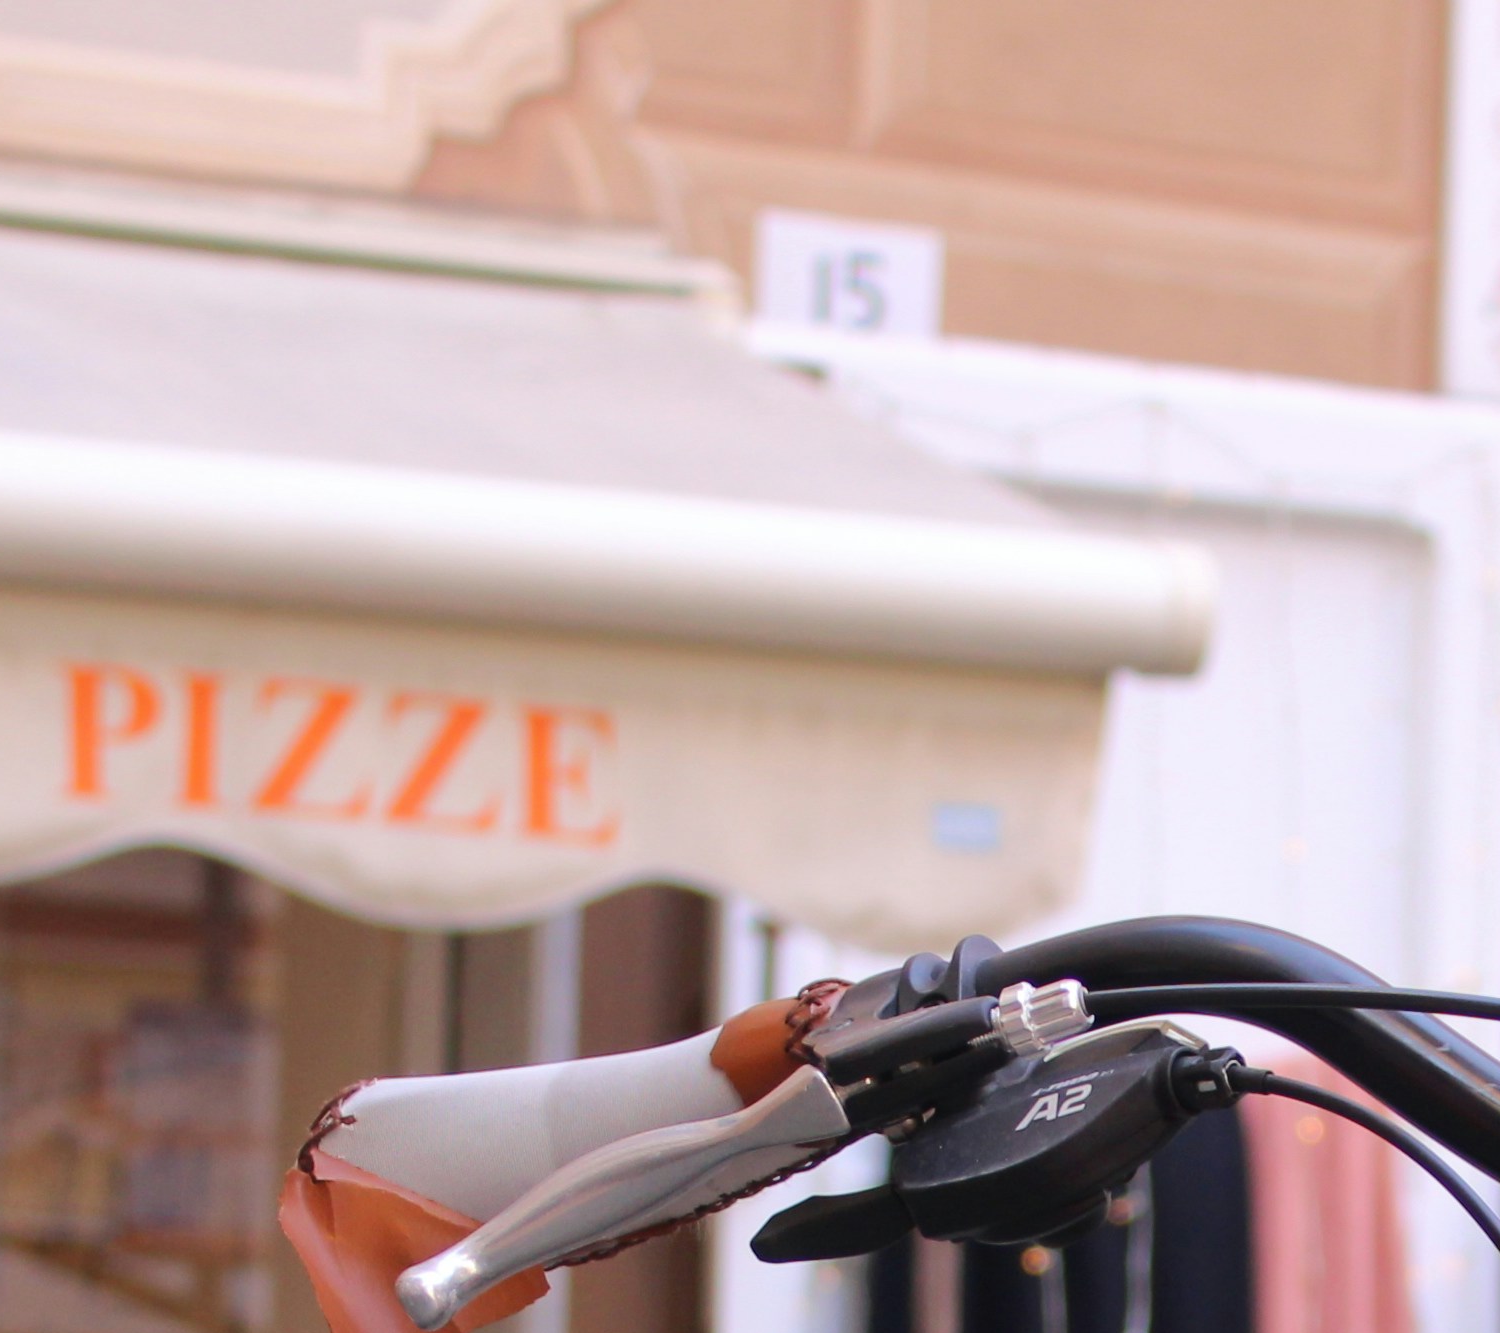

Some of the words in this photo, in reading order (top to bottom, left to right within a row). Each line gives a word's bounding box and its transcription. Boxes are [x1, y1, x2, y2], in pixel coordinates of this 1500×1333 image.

[811, 250, 889, 330] 15
[58, 661, 620, 849] PIZZE
[1014, 1082, 1093, 1133] A2
